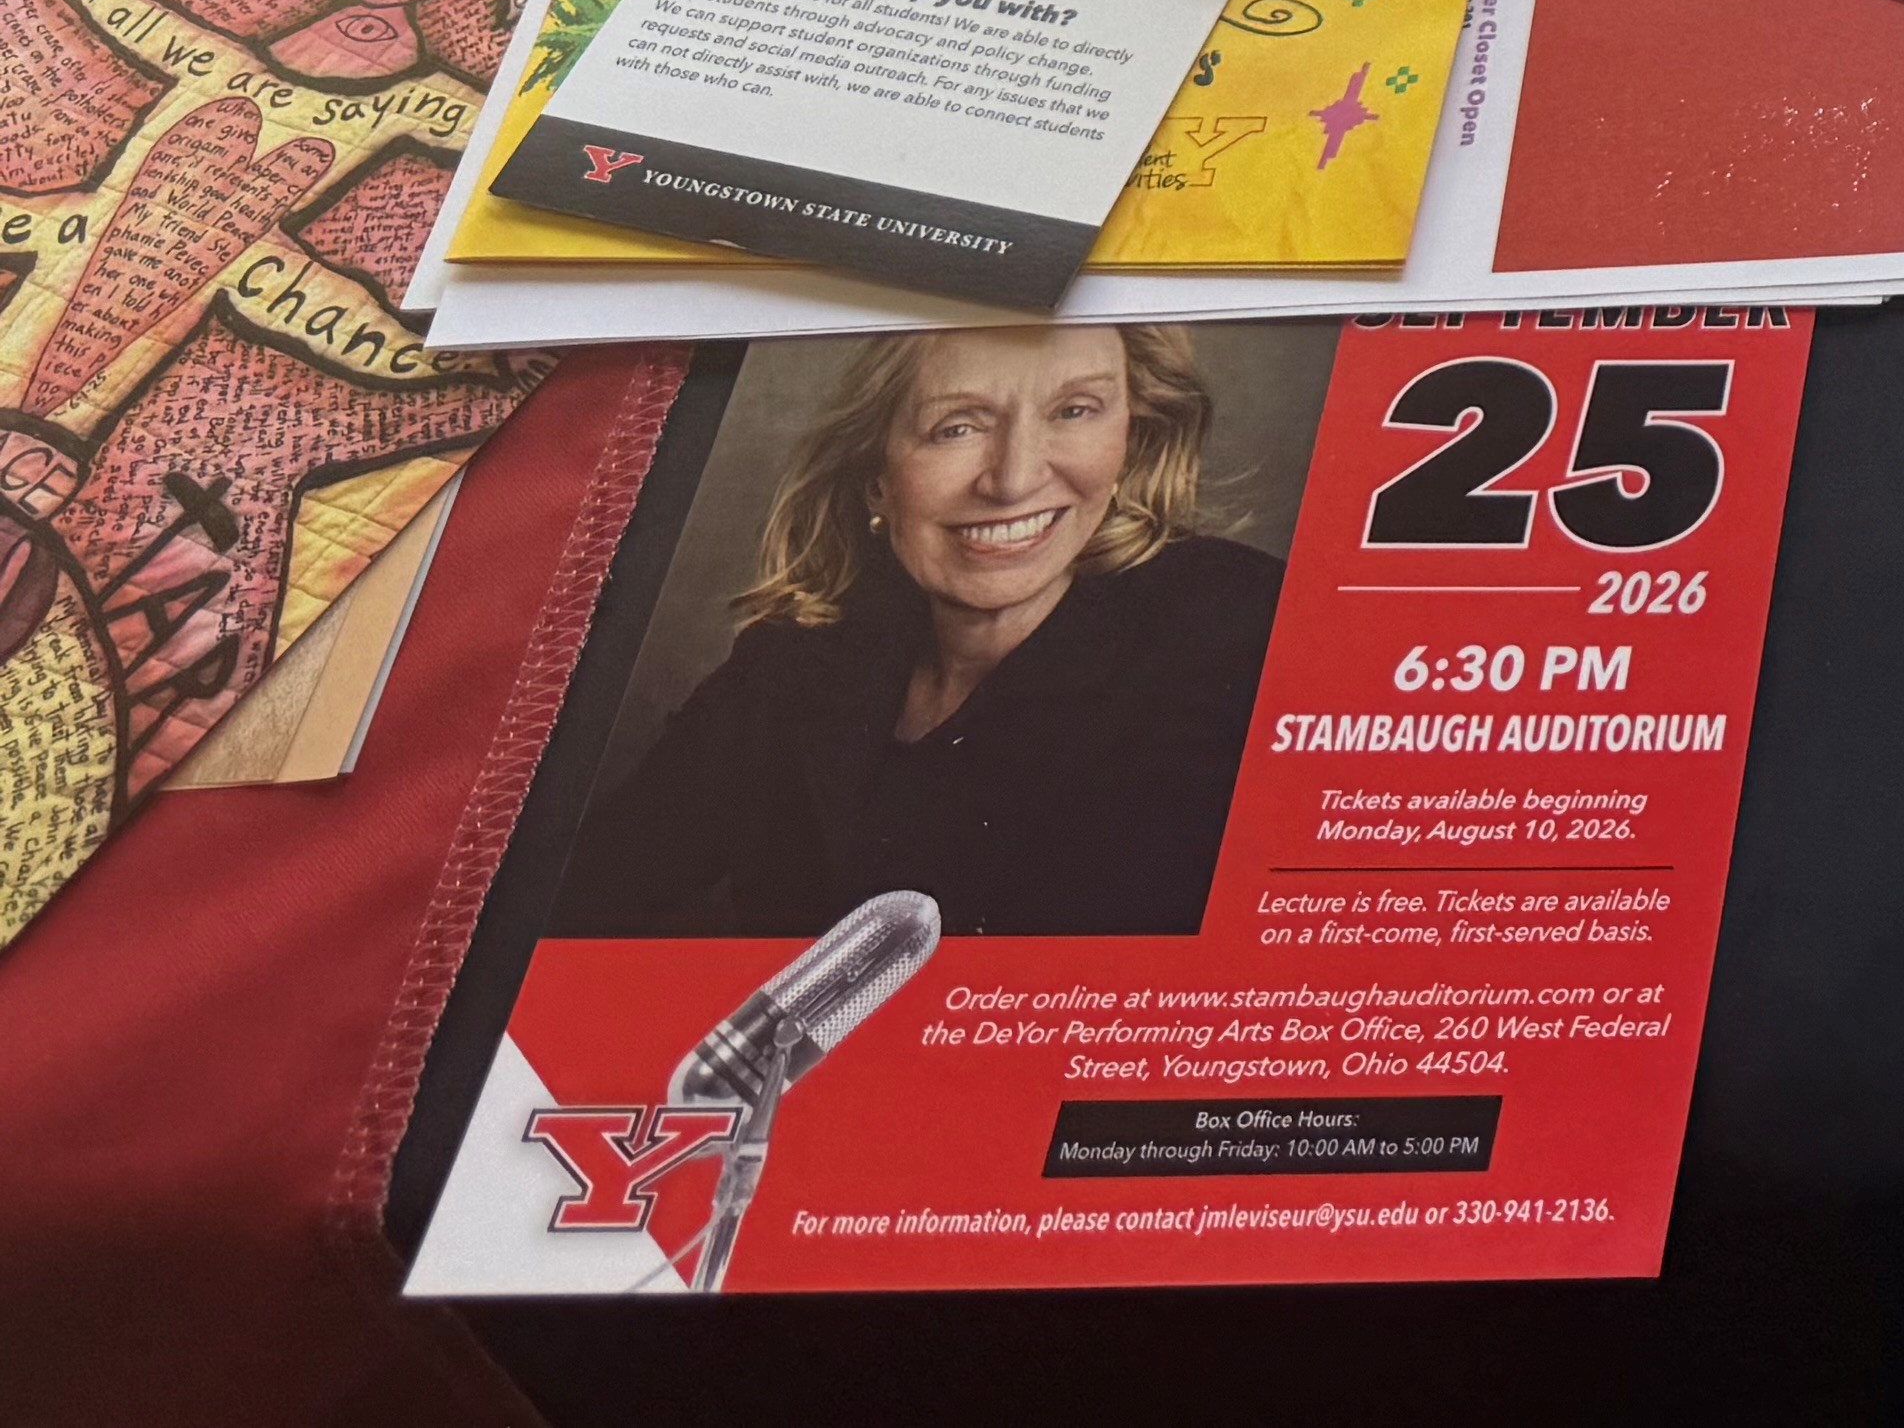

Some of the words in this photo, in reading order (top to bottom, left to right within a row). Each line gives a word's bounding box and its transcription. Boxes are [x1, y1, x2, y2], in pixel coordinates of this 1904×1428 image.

[997, 0, 1077, 26] with?
[161, 42, 212, 77] we
[226, 66, 292, 110] are
[312, 85, 468, 144] saying
[643, 169, 798, 212] YOUNGSTOWN
[802, 203, 871, 227] STATE
[876, 217, 1013, 254] UNIVERSITY
[239, 254, 475, 374] Chance.
[1361, 356, 1735, 554] 25
[1587, 570, 1708, 614] 2026
[1394, 645, 1524, 691] 6:30
[1540, 646, 1632, 690] PM
[1271, 714, 1493, 752] STAMBAUGH
[1497, 714, 1726, 752] AUDITORIUM
[1321, 789, 1402, 810] Tickets
[1407, 788, 1516, 809] available
[1522, 788, 1647, 815] beginning
[1316, 819, 1421, 844] Monday,
[1425, 820, 1517, 844] August
[1526, 819, 1558, 842] 10,
[1565, 818, 1635, 839] 2026.
[1257, 891, 1346, 913] Lecture
[1351, 891, 1371, 912] is
[1376, 889, 1426, 912] free.
[1437, 888, 1516, 912] Tickets
[1520, 896, 1558, 911] are
[1564, 888, 1670, 911] available
[1260, 928, 1292, 944] on
[1297, 928, 1312, 944] a
[1319, 920, 1441, 946] first-come,
[1450, 919, 1585, 942] first-served
[1587, 919, 1652, 941] basis.
[946, 986, 1028, 1010] Order
[1032, 984, 1117, 1009] online
[1123, 988, 1152, 1008] at
[1158, 982, 1595, 1011] www.stambaughauditorium.com
[1602, 987, 1633, 1003] or
[1637, 984, 1664, 1003] at
[792, 1209, 830, 1236] For
[832, 1213, 891, 1235] more
[895, 1207, 1032, 1237] information,
[1037, 1205, 1112, 1239] please
[1115, 1205, 1195, 1234] contact
[1196, 1200, 1420, 1237] jmleviseur@ysu.edu
[1425, 1206, 1451, 1227] or
[1452, 1198, 1616, 1225] 330-941-2136.
